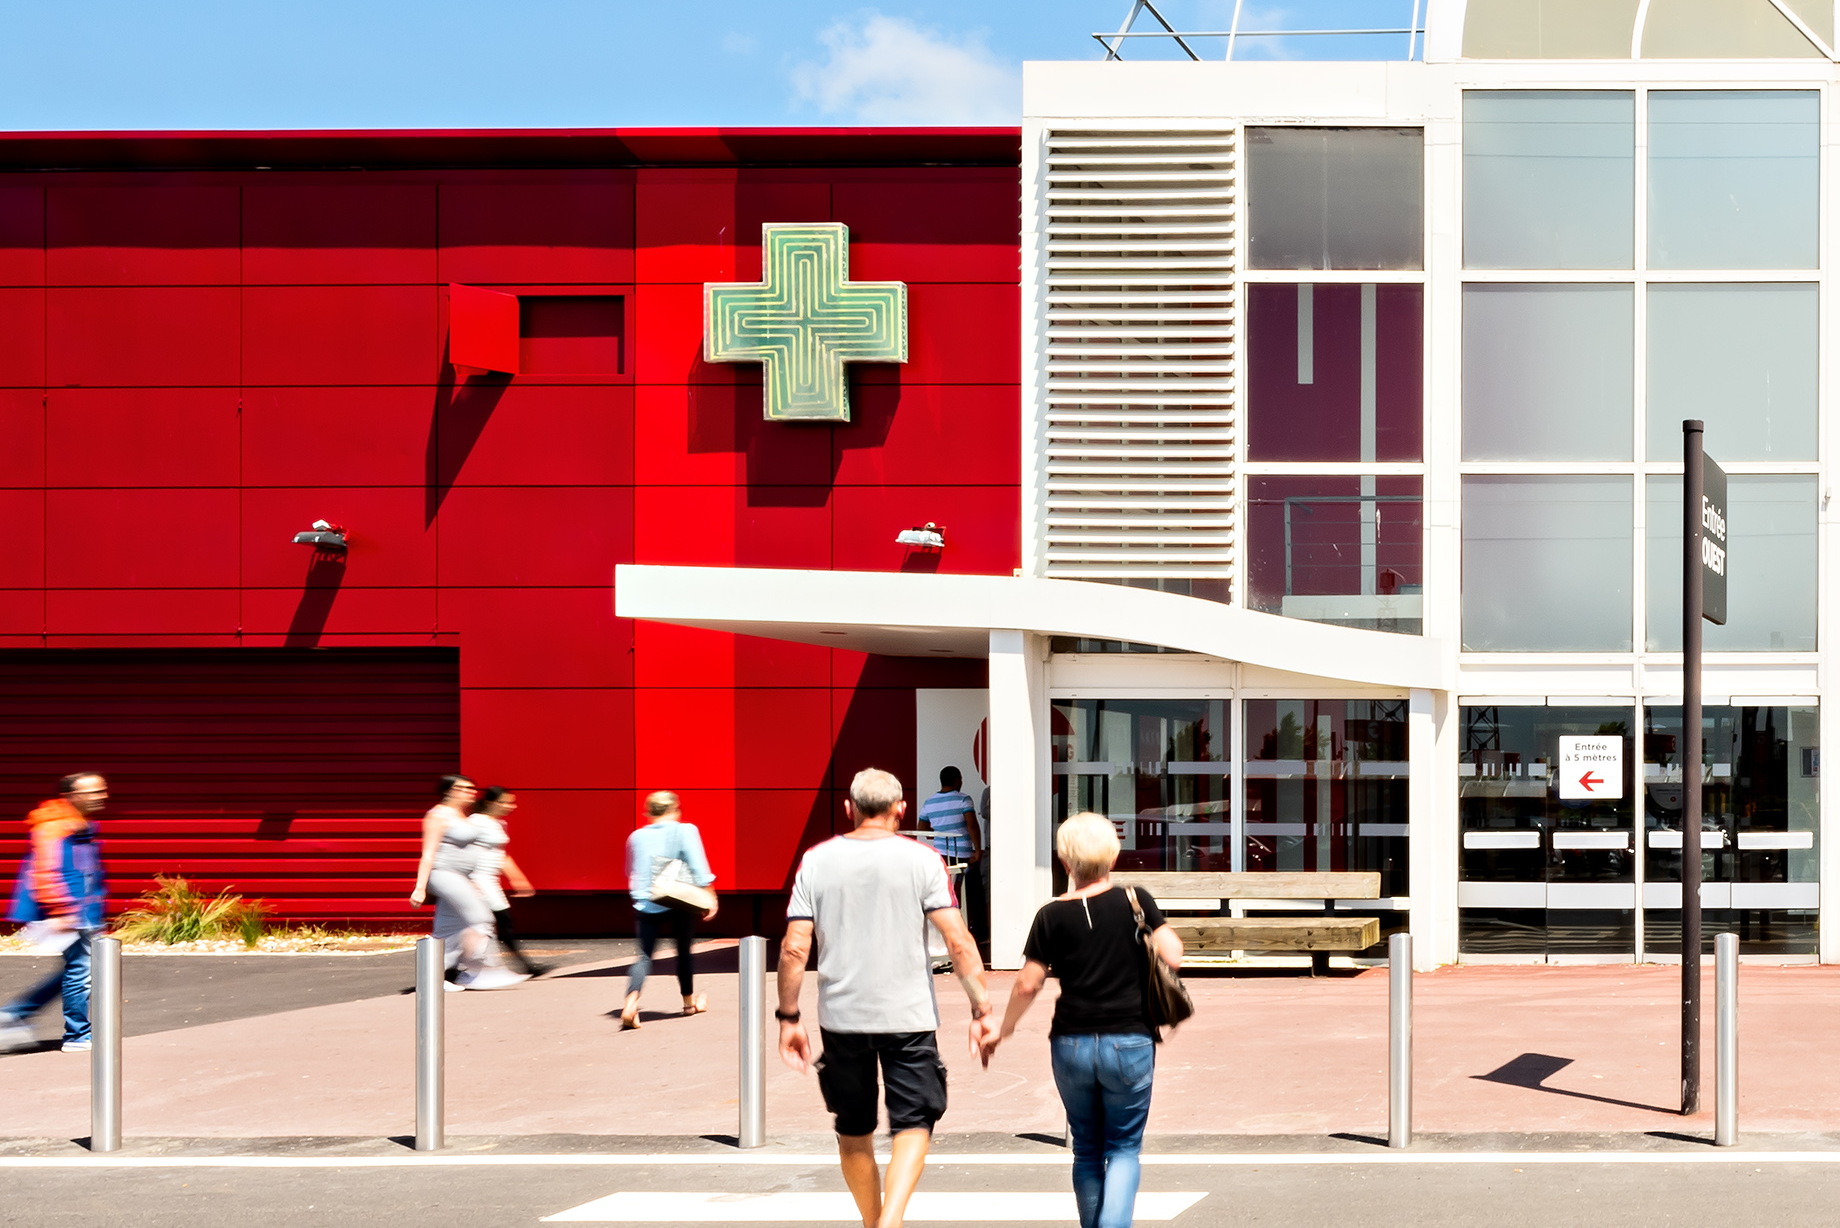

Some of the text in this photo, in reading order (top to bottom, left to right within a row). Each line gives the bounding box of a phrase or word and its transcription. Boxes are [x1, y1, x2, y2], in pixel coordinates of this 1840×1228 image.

[1702, 495, 1726, 542] Entrée
[1702, 535, 1726, 577] OUEST
[1565, 753, 1617, 762] à 5 mètres
[1574, 742, 1607, 751] Entrée
